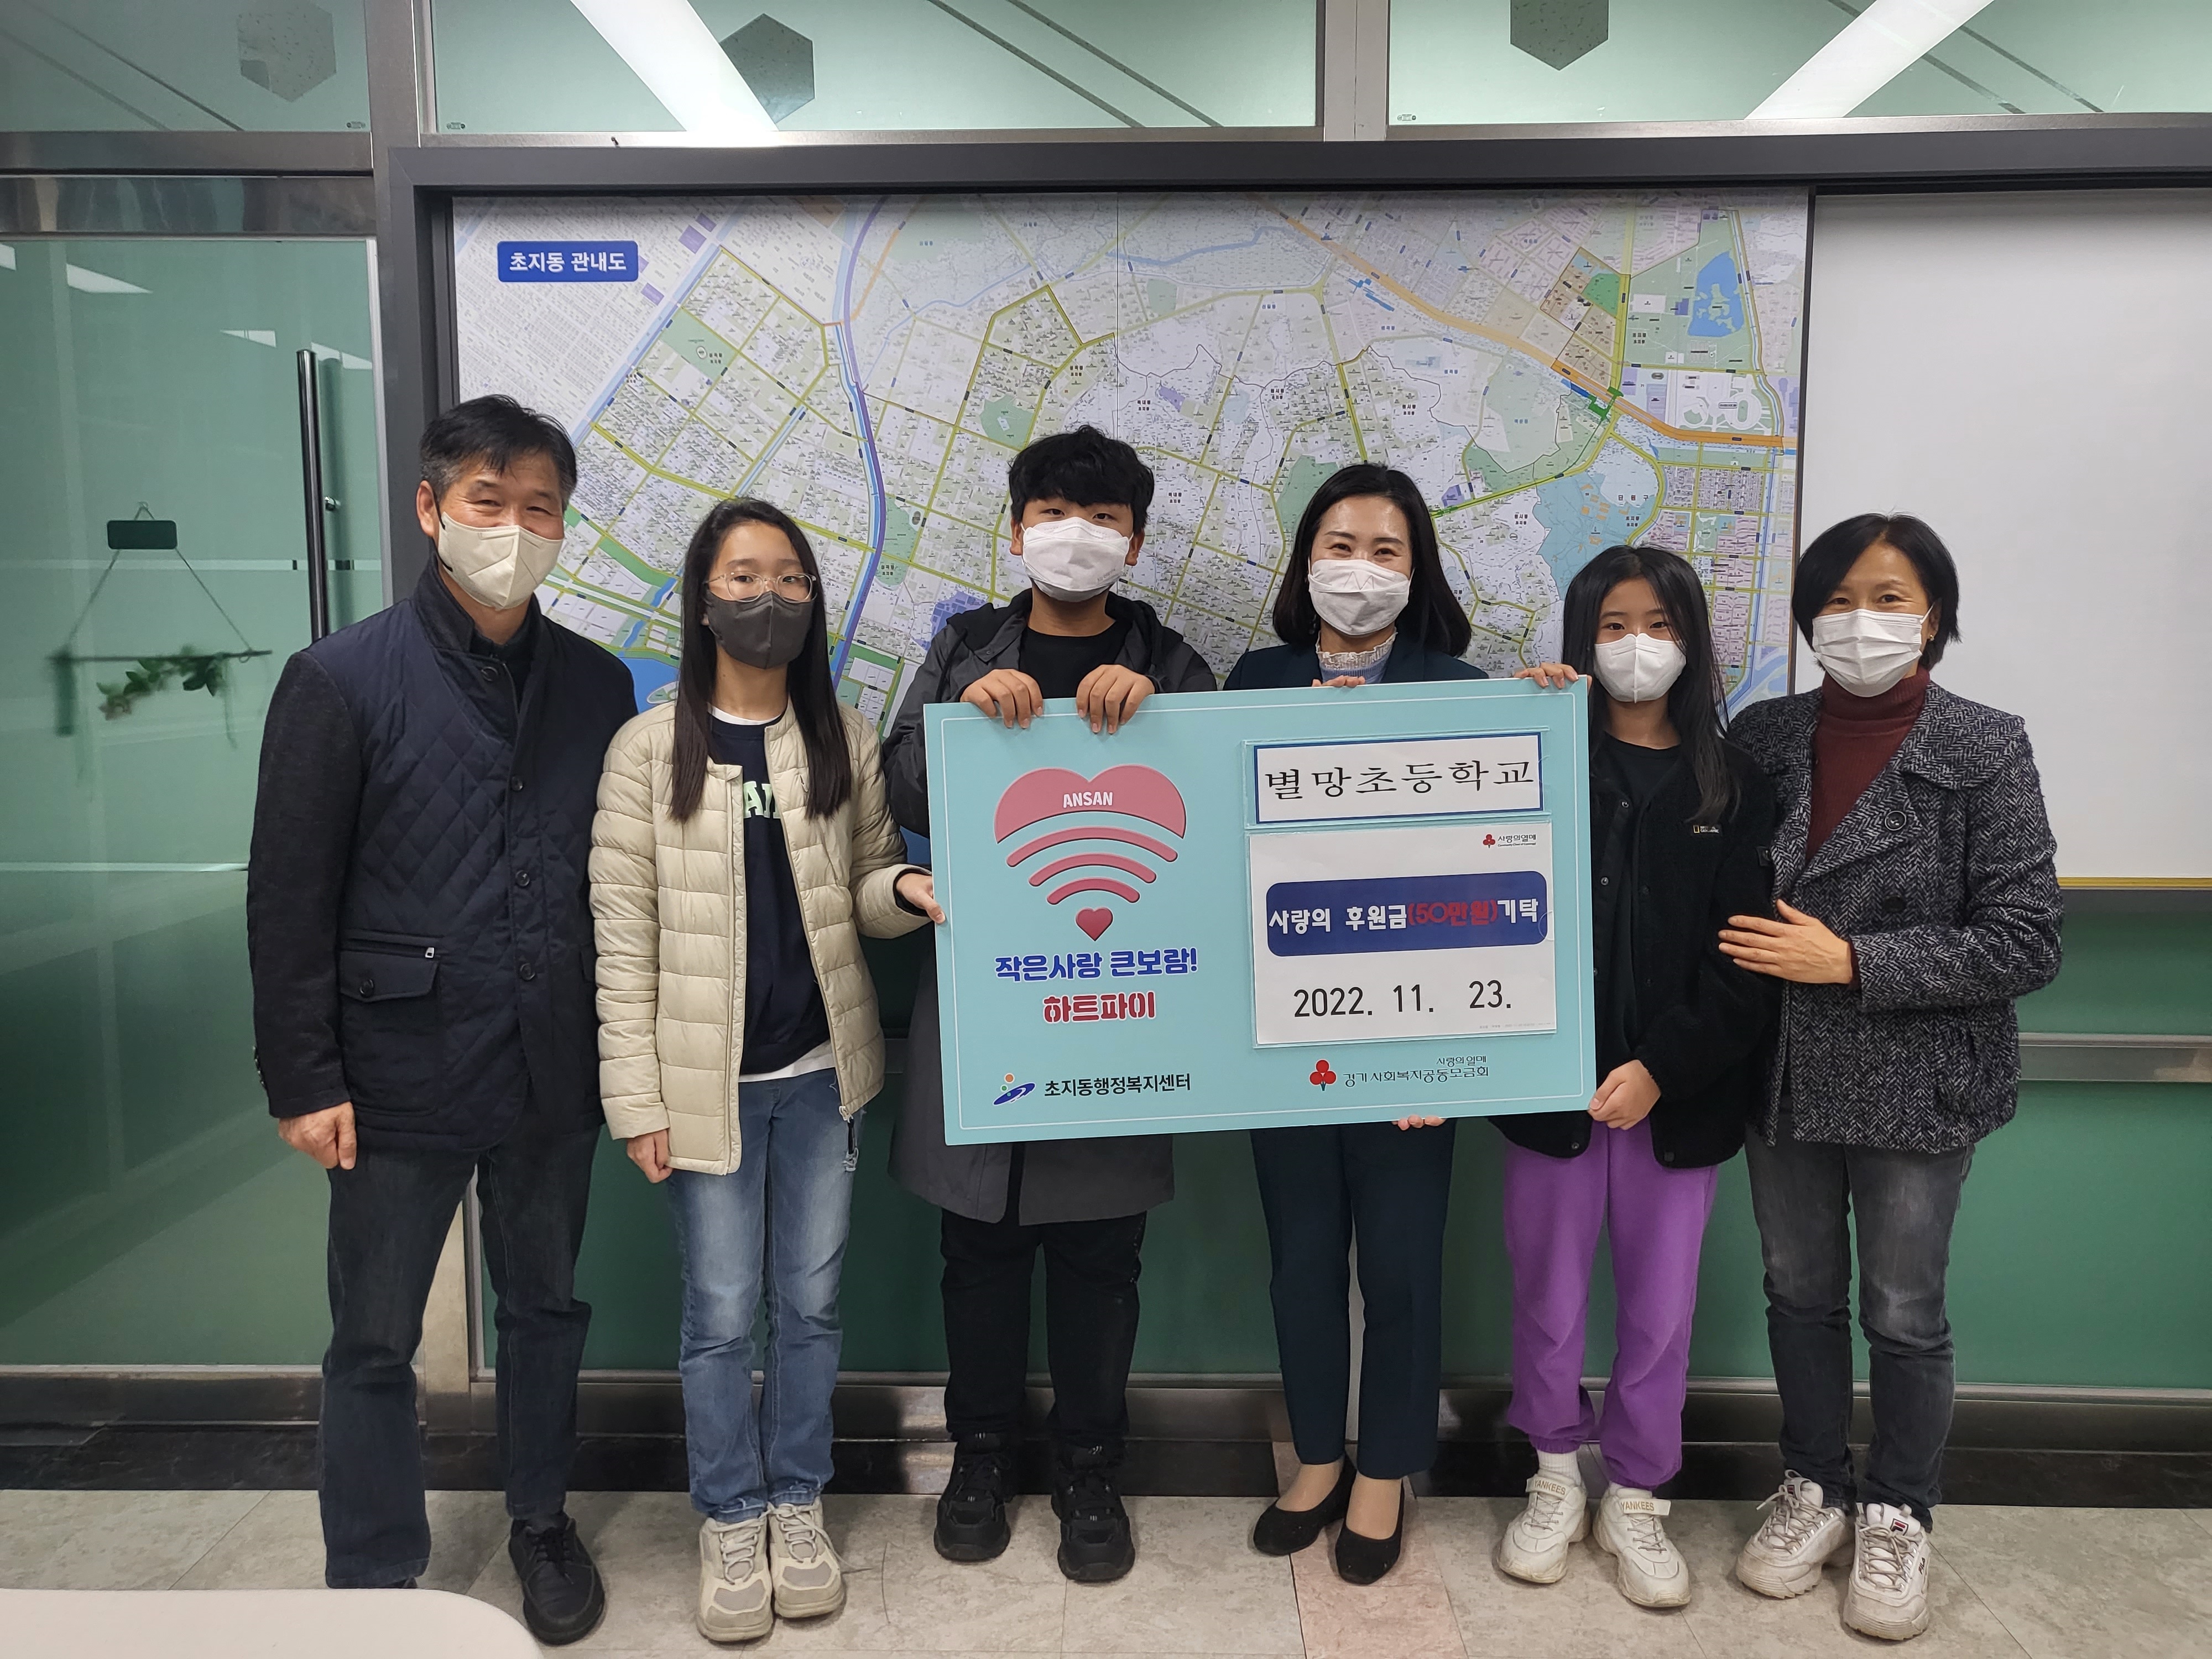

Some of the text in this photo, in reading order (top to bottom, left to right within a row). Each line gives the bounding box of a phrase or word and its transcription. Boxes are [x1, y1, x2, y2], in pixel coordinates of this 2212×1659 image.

[509, 252, 627, 272] 초지동 관내도
[1265, 760, 1534, 800] 별망초등학교
[1063, 791, 1113, 808] ANSAN
[1269, 908, 1331, 935] 사랑의
[995, 947, 1198, 982] 작은사랑 큰보람!
[1043, 991, 1156, 1023] 하트파이
[1293, 979, 1511, 1018] 2022. 11. 23.
[1044, 1073, 1191, 1097] 초지동행정복지센터
[1533, 1480, 1566, 1495] YANKEES
[1620, 1501, 1655, 1511] YANKEES
